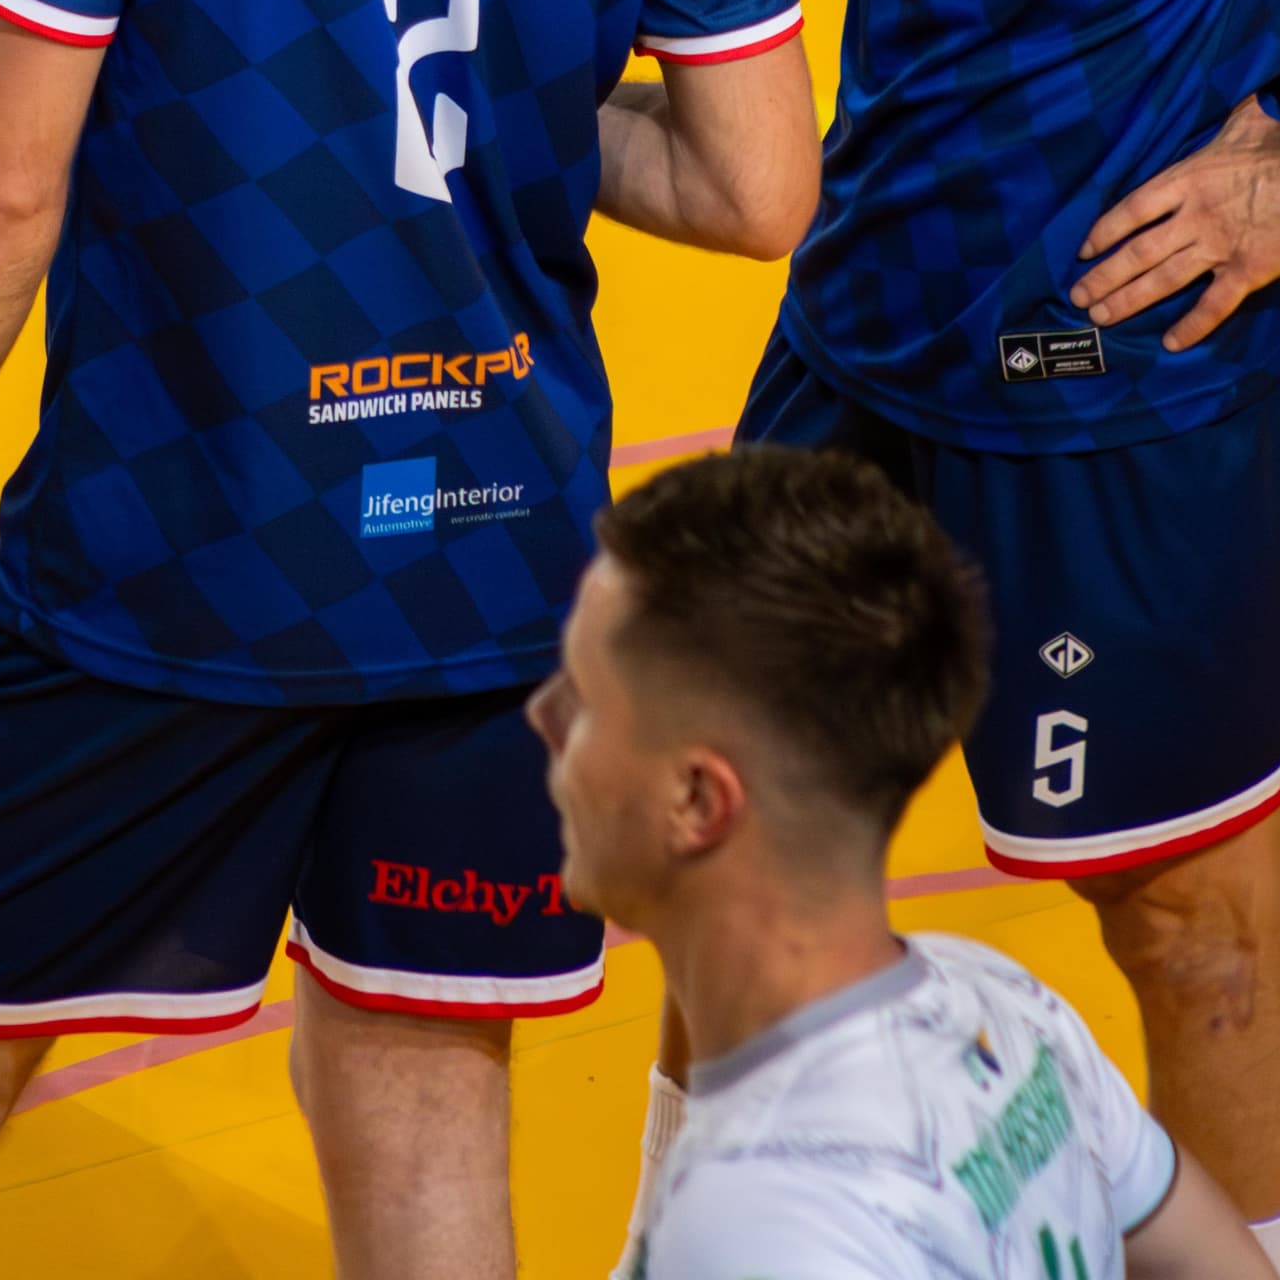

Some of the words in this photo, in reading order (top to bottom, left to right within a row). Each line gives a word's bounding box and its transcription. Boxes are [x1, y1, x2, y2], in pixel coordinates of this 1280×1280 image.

[308, 392, 407, 425] SANDWICH
[411, 390, 483, 412] PANELS
[363, 518, 433, 535] Automotive
[1032, 709, 1089, 808] 5
[368, 859, 532, 927] Elchy
